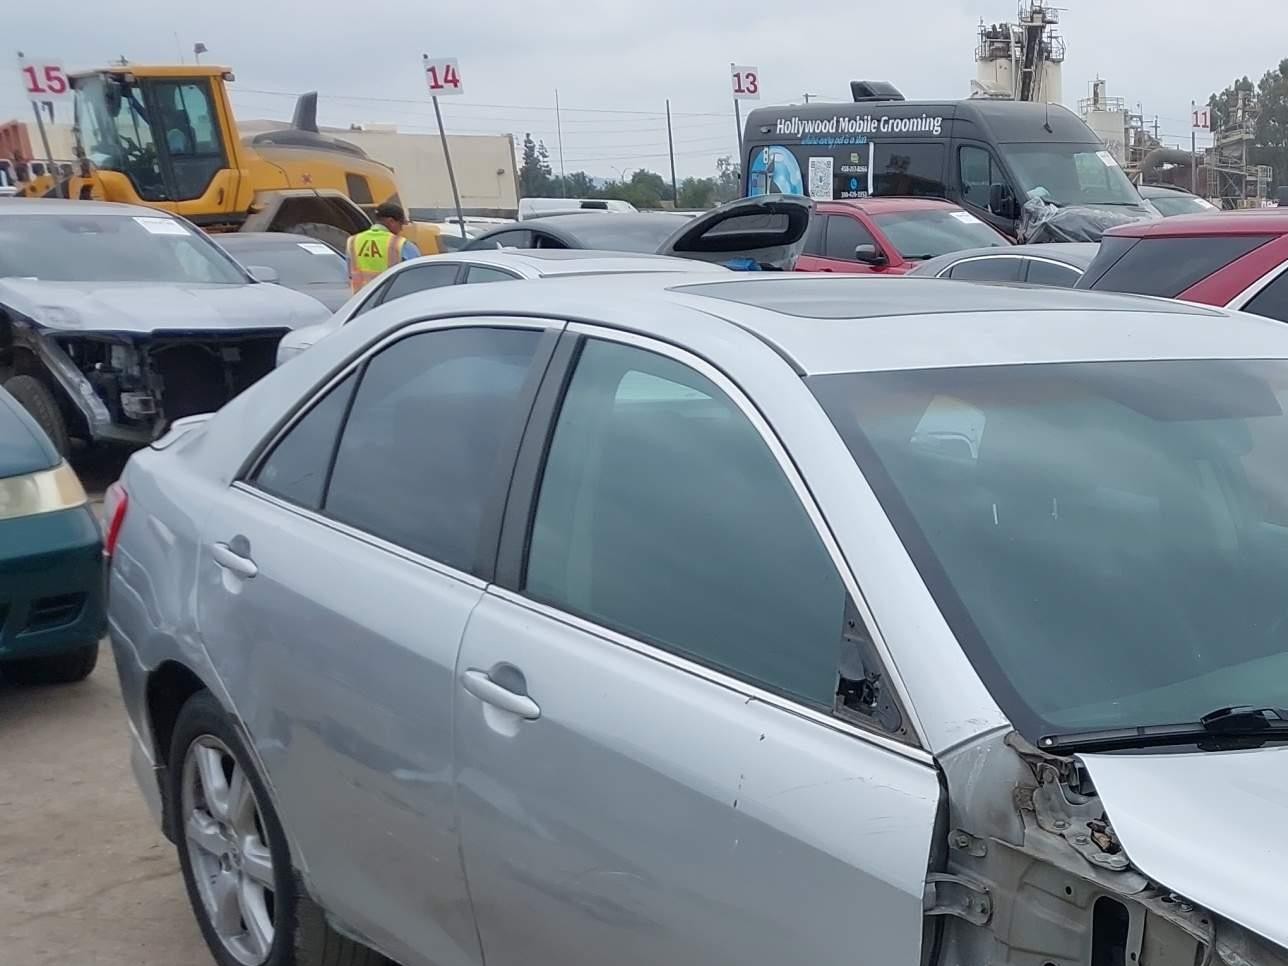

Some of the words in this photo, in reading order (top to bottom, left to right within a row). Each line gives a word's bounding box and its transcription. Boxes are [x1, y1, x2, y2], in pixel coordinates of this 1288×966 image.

[23, 66, 66, 93] 15
[426, 64, 460, 89] 14
[733, 72, 758, 94] 13
[776, 116, 837, 137] Hollywood
[838, 115, 878, 133] Mobile
[880, 114, 943, 135] Grooming
[1192, 110, 1210, 128] 11
